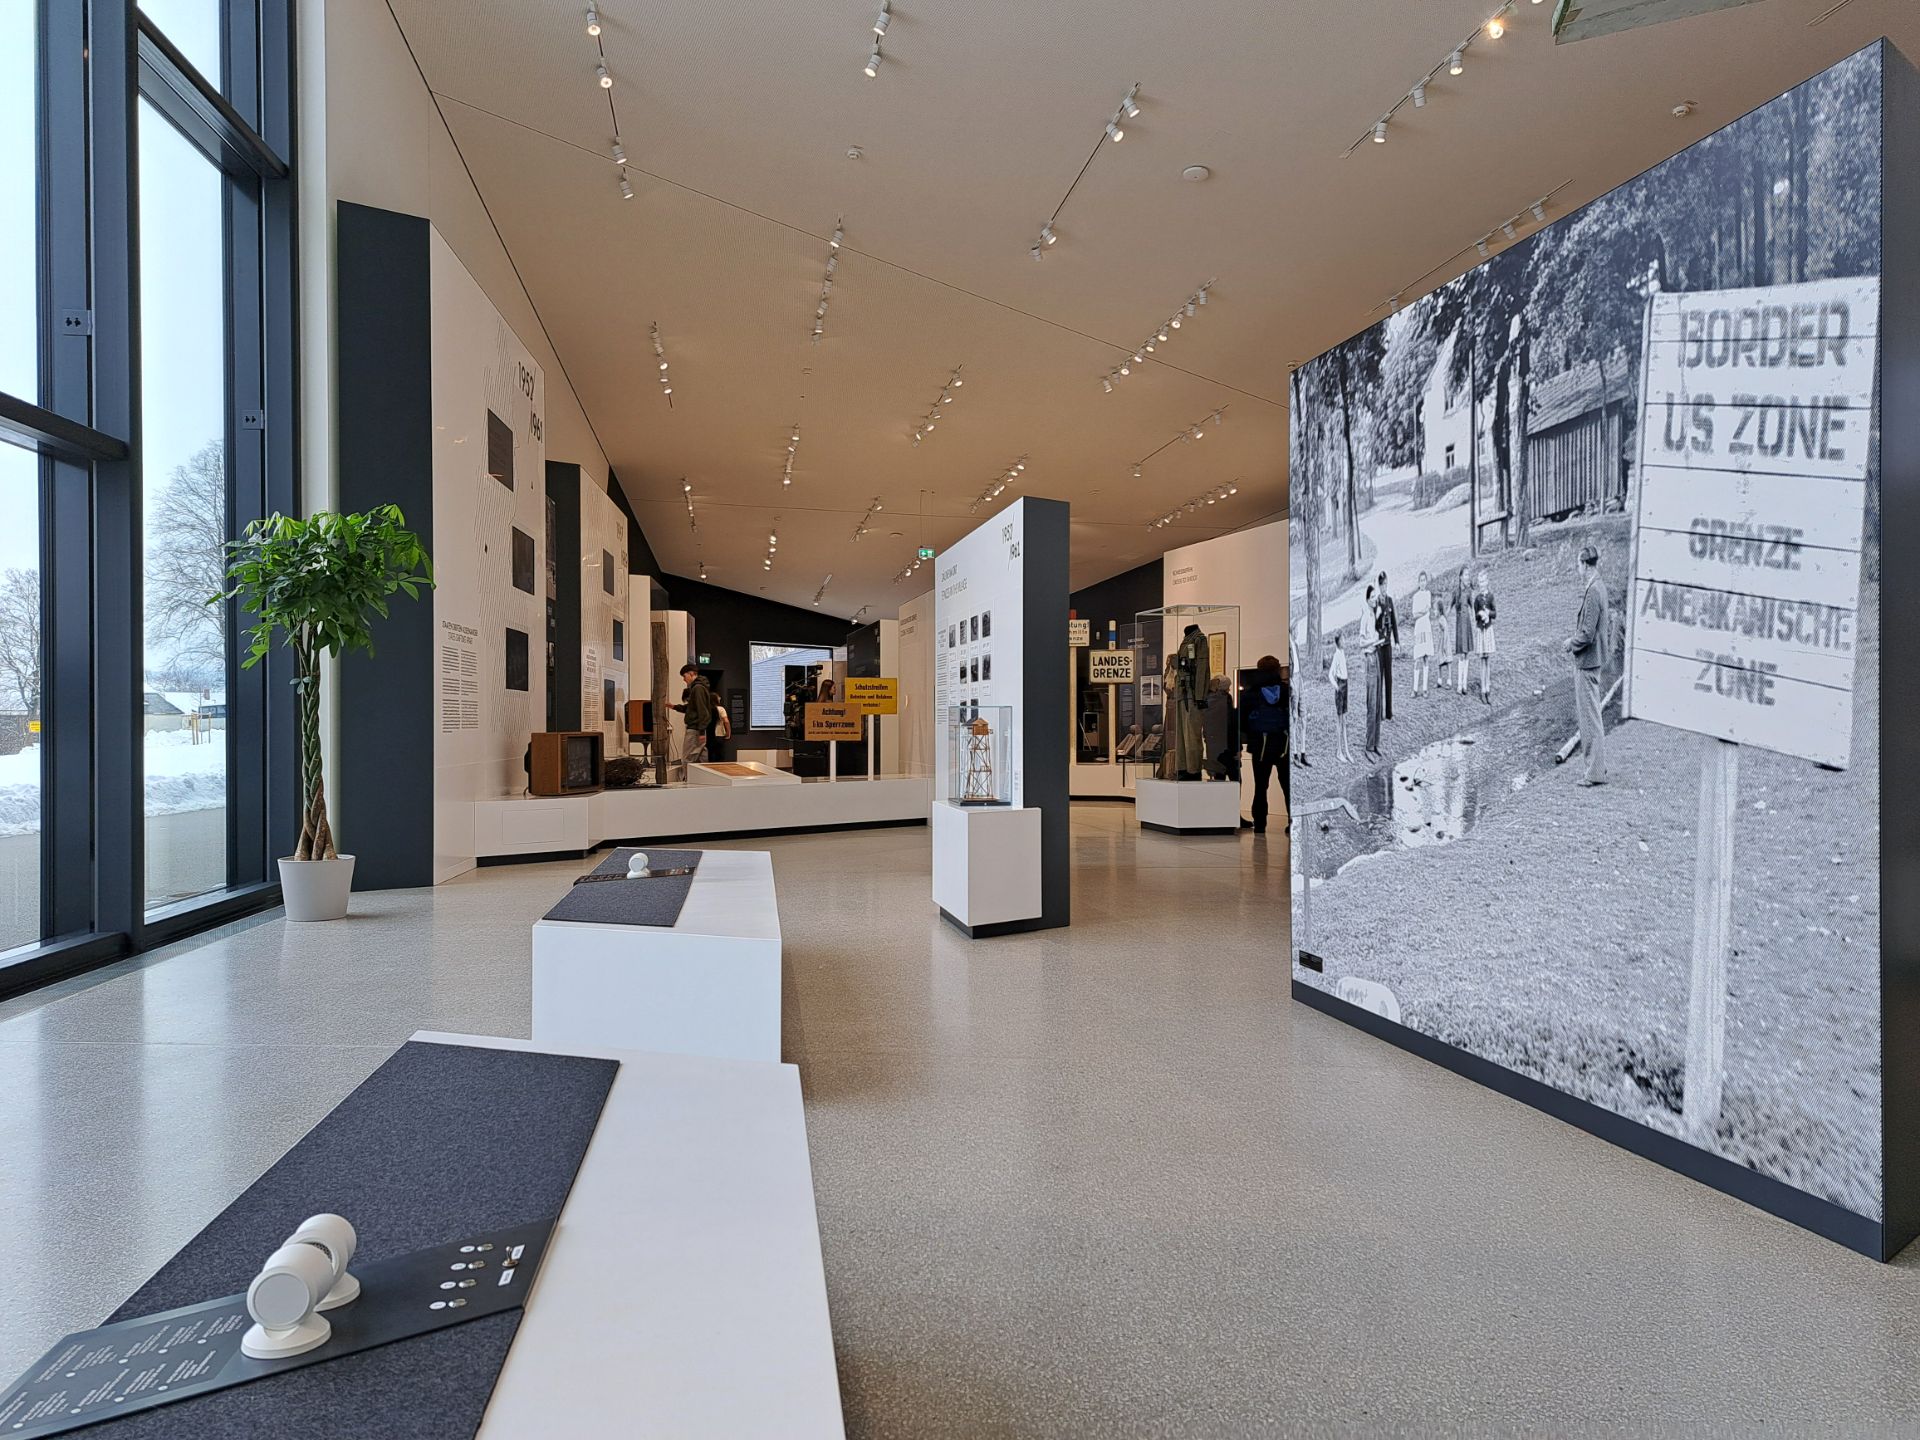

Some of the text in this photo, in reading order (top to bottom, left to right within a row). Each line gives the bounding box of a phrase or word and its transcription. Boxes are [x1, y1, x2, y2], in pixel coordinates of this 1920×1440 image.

[1678, 302, 1850, 368] BORDER
[518, 361, 535, 401] 1952
[1664, 391, 1850, 460] US ZONE
[1688, 518, 1804, 571] GRENZE
[1092, 656, 1133, 667] LANDES-
[1093, 668, 1132, 679] GRENZE
[1694, 649, 1778, 706] ZONE
